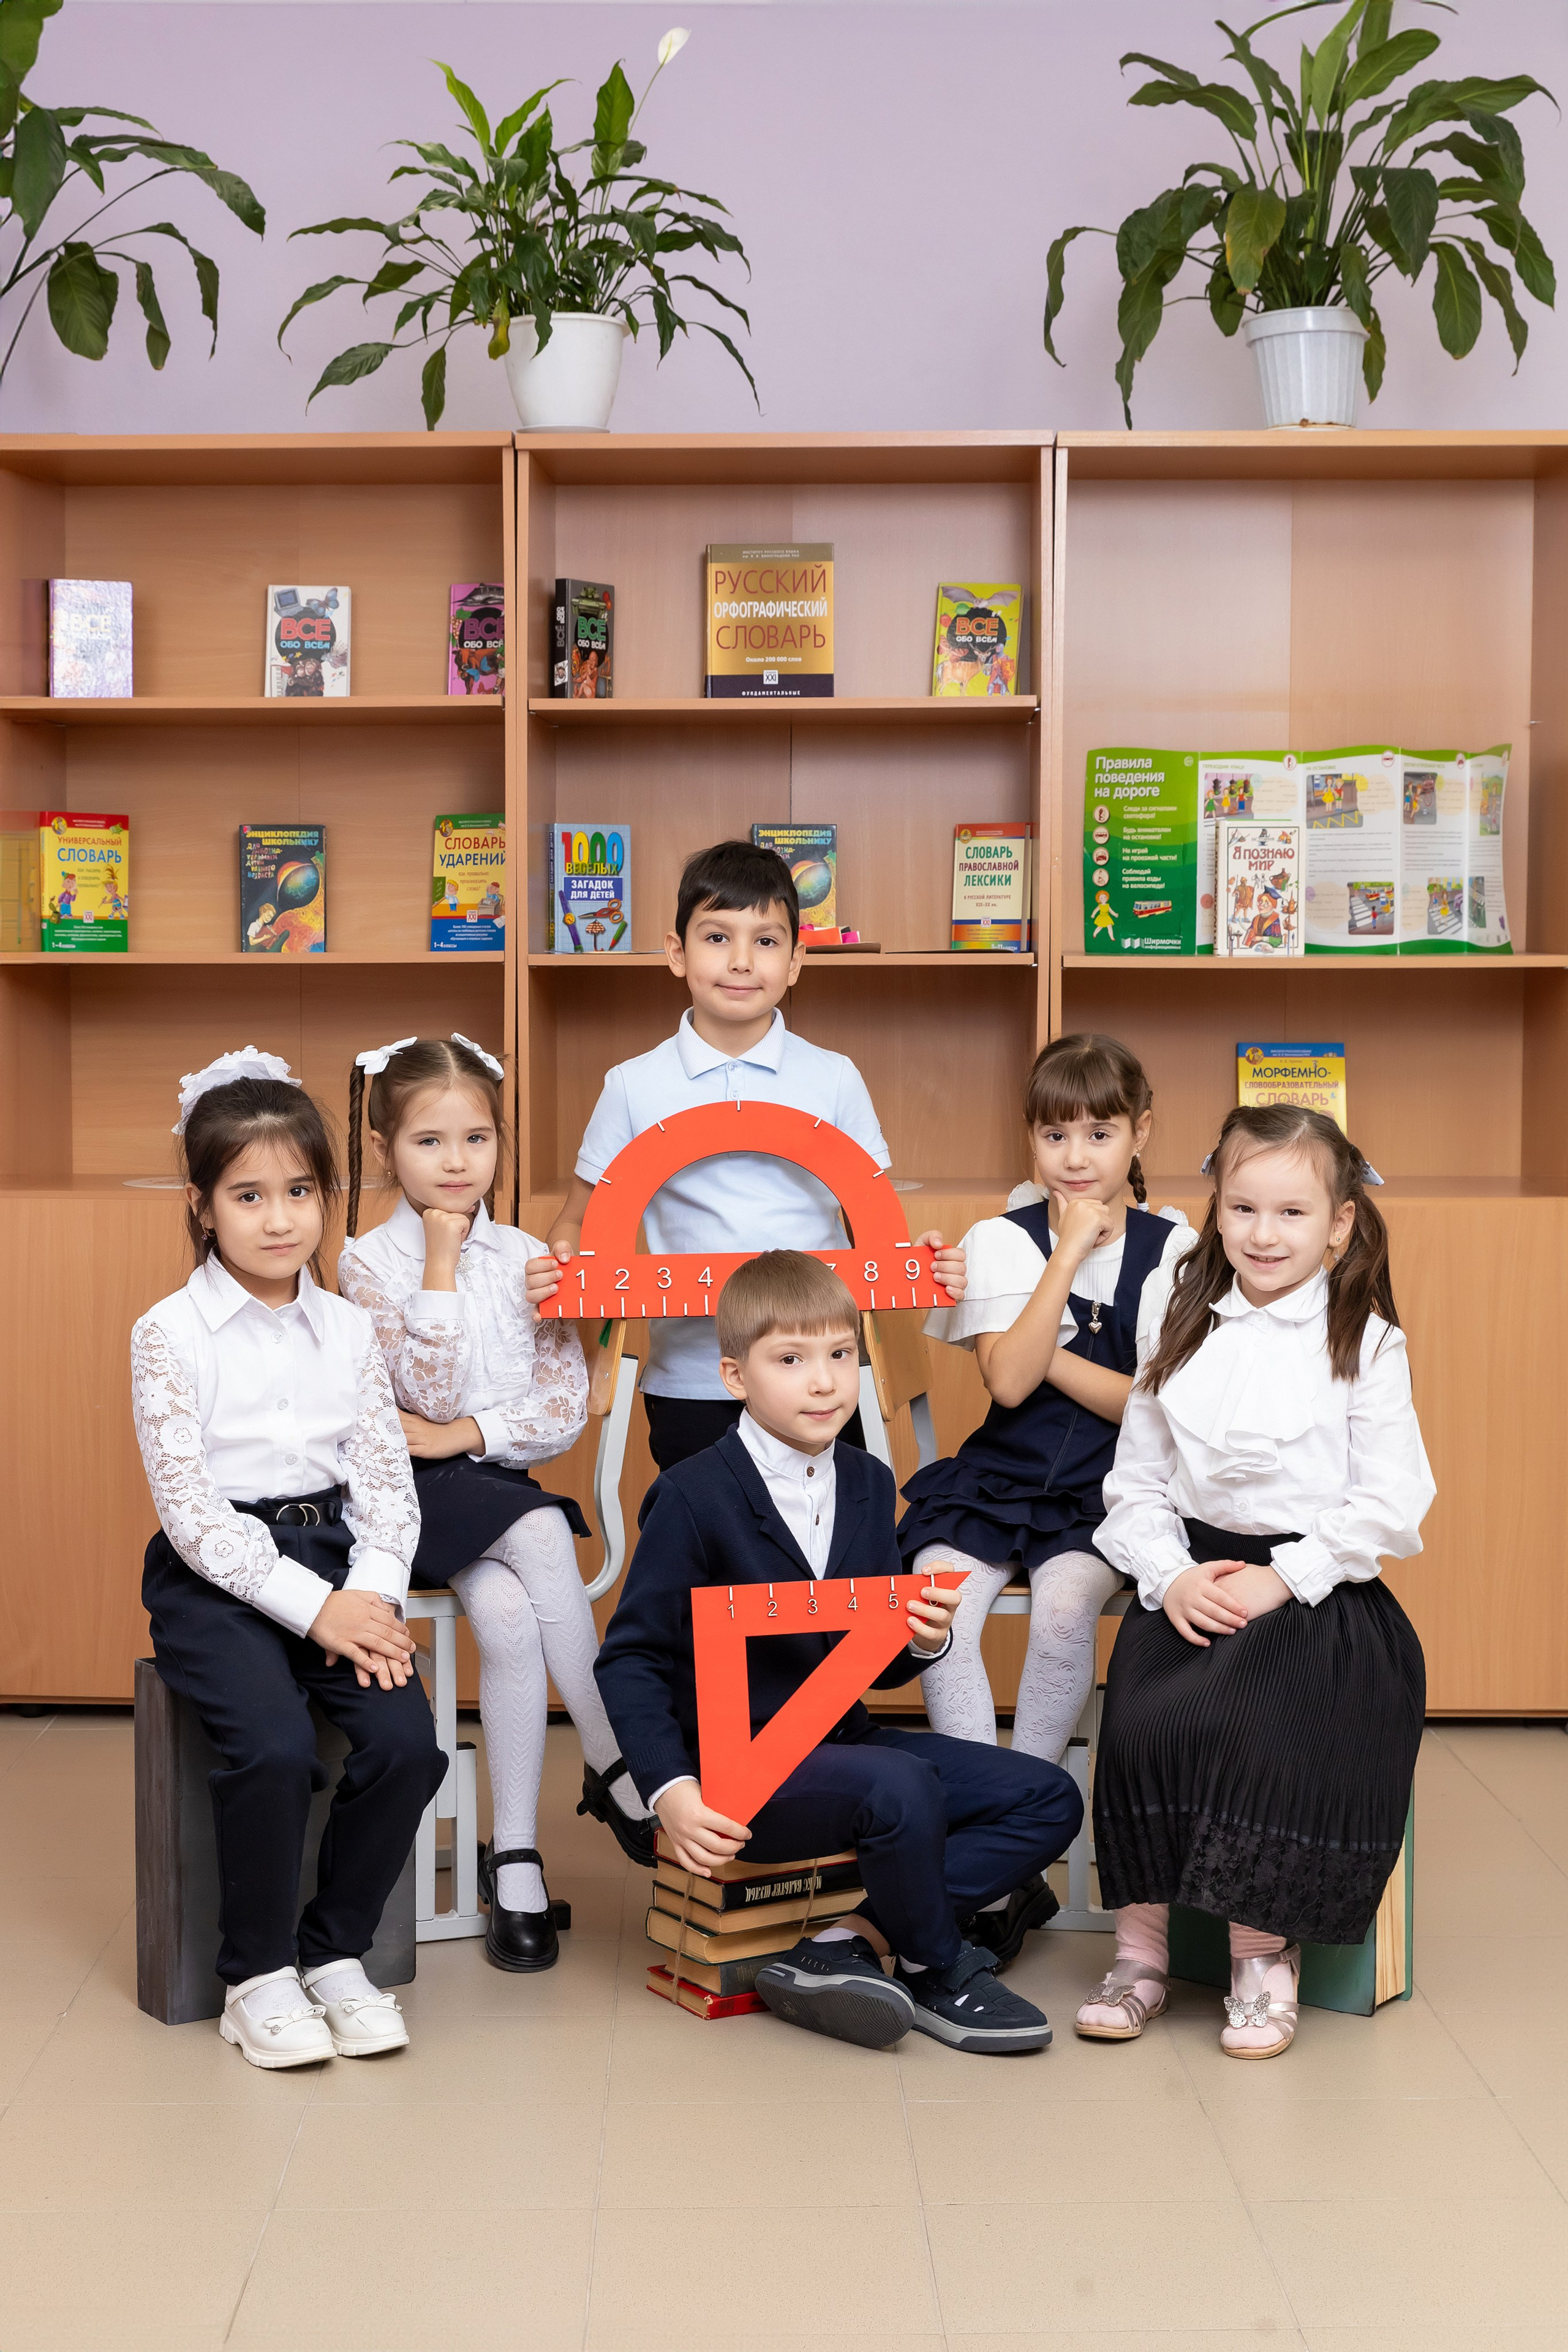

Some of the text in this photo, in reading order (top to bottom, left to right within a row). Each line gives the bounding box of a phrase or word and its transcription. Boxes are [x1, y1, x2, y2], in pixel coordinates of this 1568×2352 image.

[715, 564, 826, 594] РУССКИЙ
[714, 596, 827, 619] ОРФОГРАФИЧЕСКИЙ
[463, 638, 504, 649] ОБО ВСЁ
[578, 639, 590, 648] ОБО
[716, 624, 826, 650] СЛОВАРЬ
[1095, 756, 1153, 772] Правила
[1095, 772, 1165, 785] поведения
[1094, 786, 1161, 801] на дороге
[58, 836, 122, 846] УНИВЕРСАЛЬНЫЙ
[445, 836, 506, 850] СЛОВАРЬ
[57, 848, 122, 863] СЛОВАРЬ
[562, 831, 624, 873] 1000
[965, 846, 1013, 859] СЛОВАРЬ
[1232, 846, 1295, 860] Я ПОЗНАЮ
[565, 862, 618, 875] ВЕСЕЛЫХ
[959, 859, 1019, 872] ПРАВОСЛАВНОЙ
[1248, 861, 1275, 871] МИР
[247, 871, 274, 880] ВОЗРАСТА
[963, 874, 1012, 886] ЛЕКСИКИ
[571, 880, 614, 891] ЗАГАДОК
[570, 890, 615, 900] ДЛЯ ДЕТЕЙ
[1144, 937, 1182, 947] Ширмочки
[1252, 1067, 1332, 1078] МОРФЕМНО-
[1245, 1080, 1339, 1089] СЛОВООБРАЗОВАТЕЛЬНЫЙ
[1256, 1092, 1329, 1106] СЛОВАРЬ
[576, 1259, 921, 1290] 1 2 3 4 8 9
[727, 1593, 899, 1619] 1 2 3 4 5
[745, 1884, 772, 1903] ШУЛЬЦ
[771, 1879, 802, 1897] ВАЛЬТЕР
